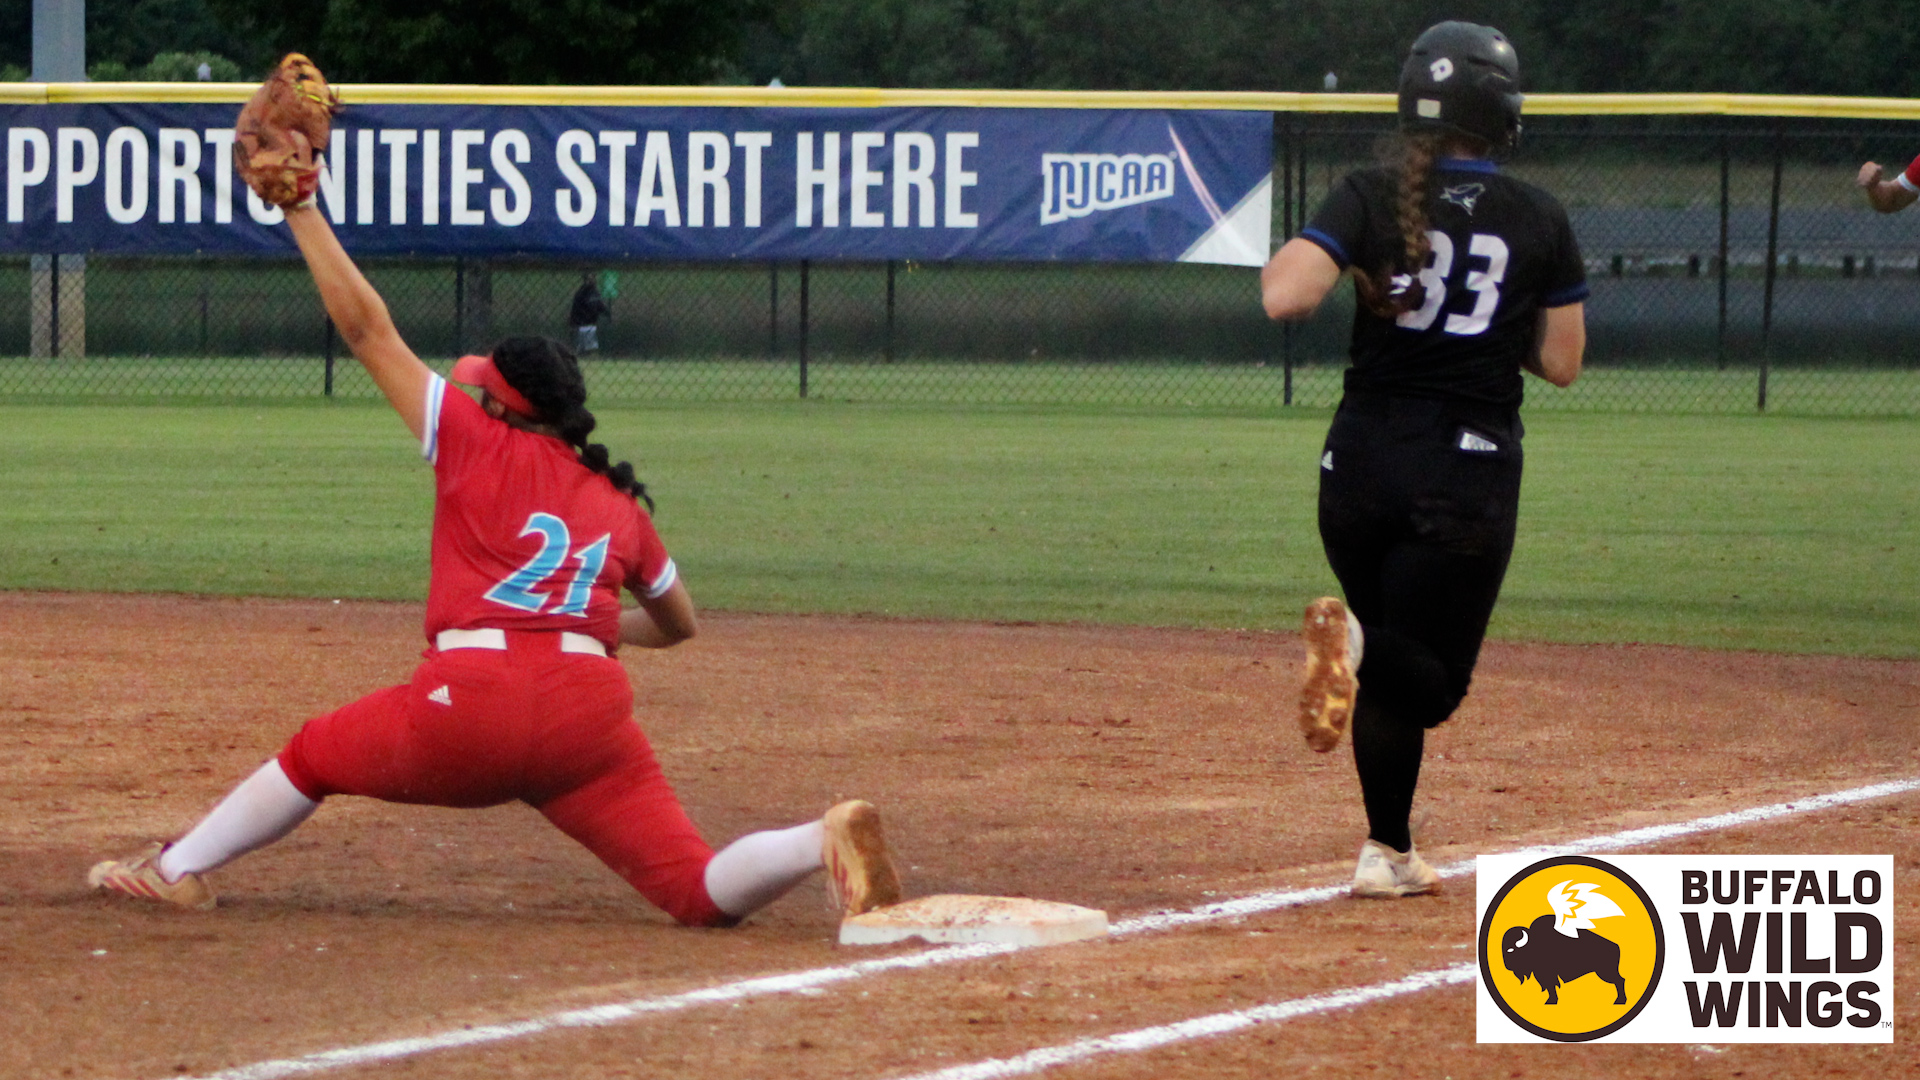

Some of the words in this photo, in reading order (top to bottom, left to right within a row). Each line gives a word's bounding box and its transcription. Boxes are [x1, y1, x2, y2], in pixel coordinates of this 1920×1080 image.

[555, 129, 773, 229] START
[796, 131, 980, 229] HERE
[1045, 156, 1171, 221] NJCAA
[1396, 229, 1510, 335] 33
[482, 512, 611, 618] 21
